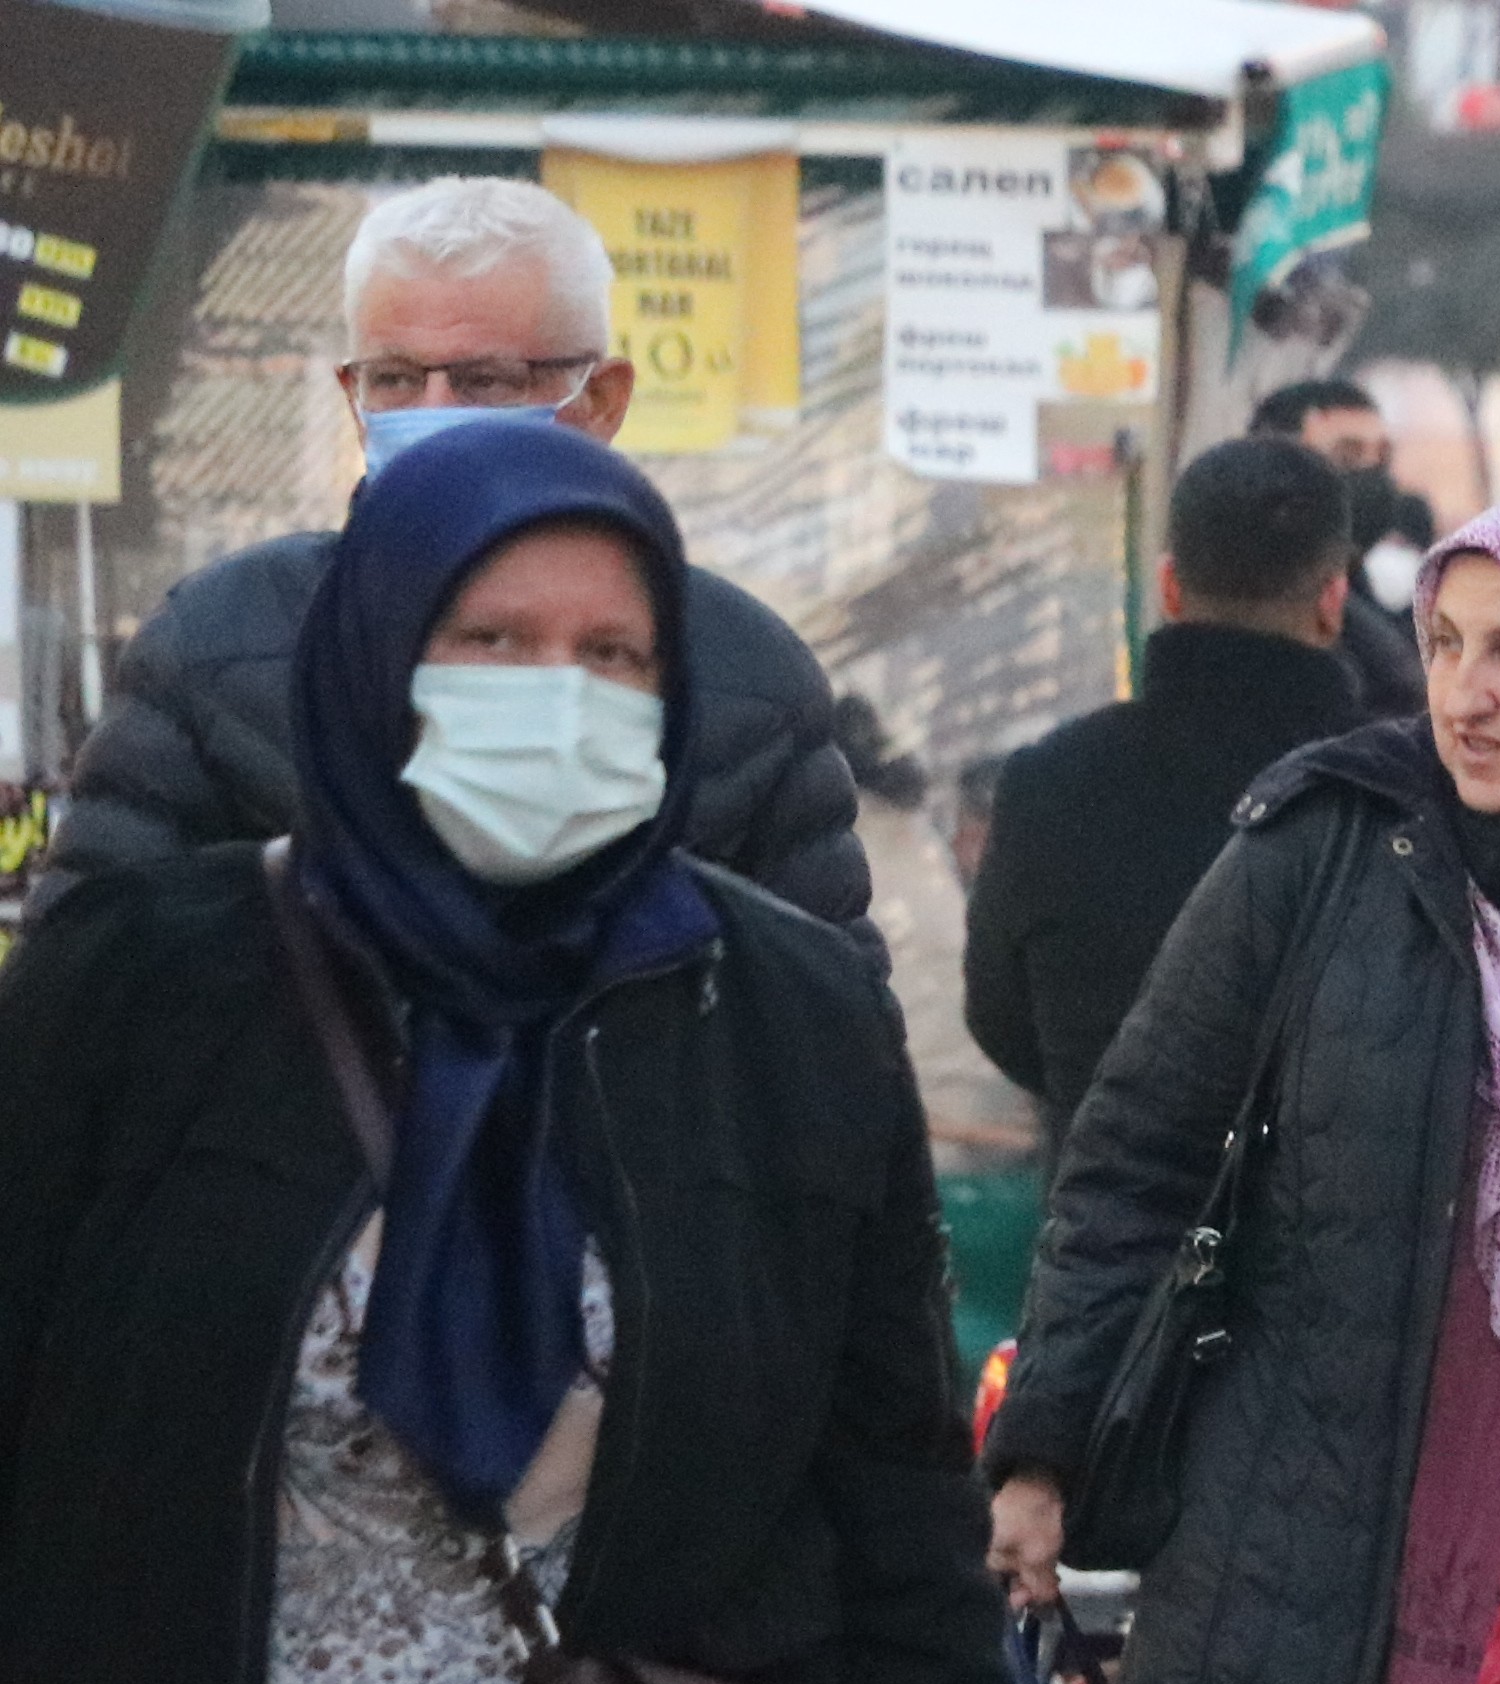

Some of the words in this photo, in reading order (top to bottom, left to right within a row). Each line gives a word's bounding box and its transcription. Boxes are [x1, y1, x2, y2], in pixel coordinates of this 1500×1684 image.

[897, 166, 1053, 197] салеп
[634, 207, 694, 240] TAZE
[608, 251, 734, 280] ORTAKAL
